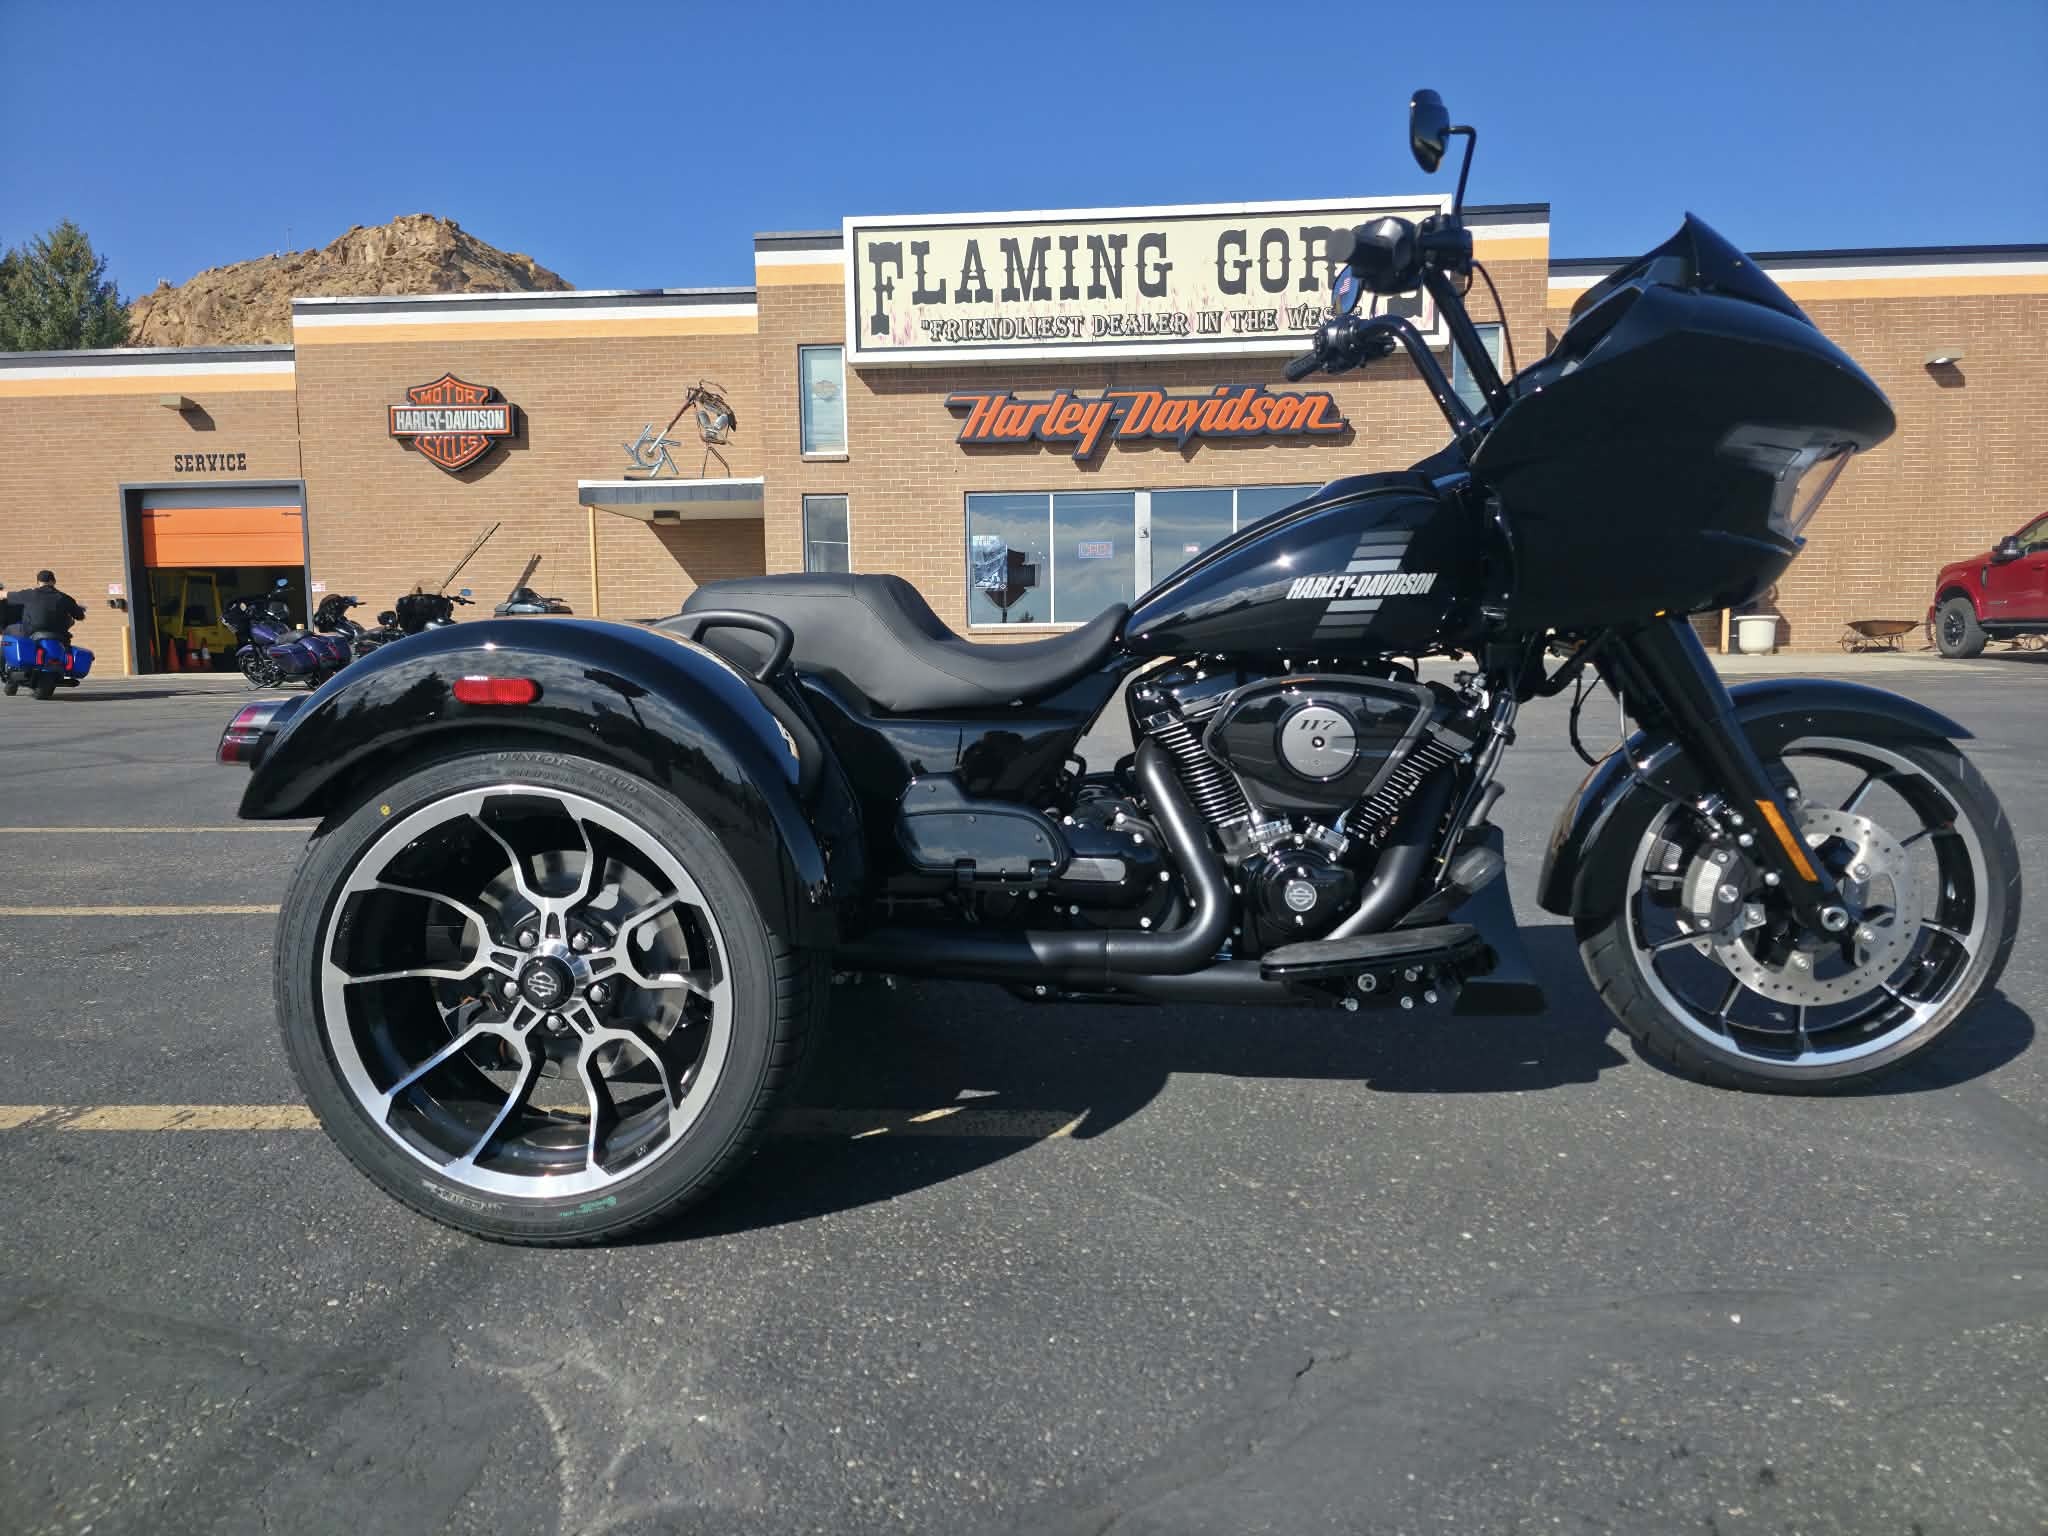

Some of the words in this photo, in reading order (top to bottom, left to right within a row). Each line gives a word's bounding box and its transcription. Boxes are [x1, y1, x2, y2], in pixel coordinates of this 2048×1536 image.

[868, 231, 1173, 335] FLAMING
[1092, 311, 1188, 337] DEALER
[1196, 310, 1223, 333] IN
[1229, 308, 1278, 332] THE
[420, 381, 478, 404] MOTOR
[396, 410, 505, 430] HARLEY-DAVIDSON
[948, 385, 1347, 458] Harley-Davidson
[422, 436, 481, 461] CYCLES
[174, 453, 247, 472] SERVICE
[1285, 573, 1438, 599] HARLEY-DAVIDSON
[1299, 719, 1337, 731] 117
